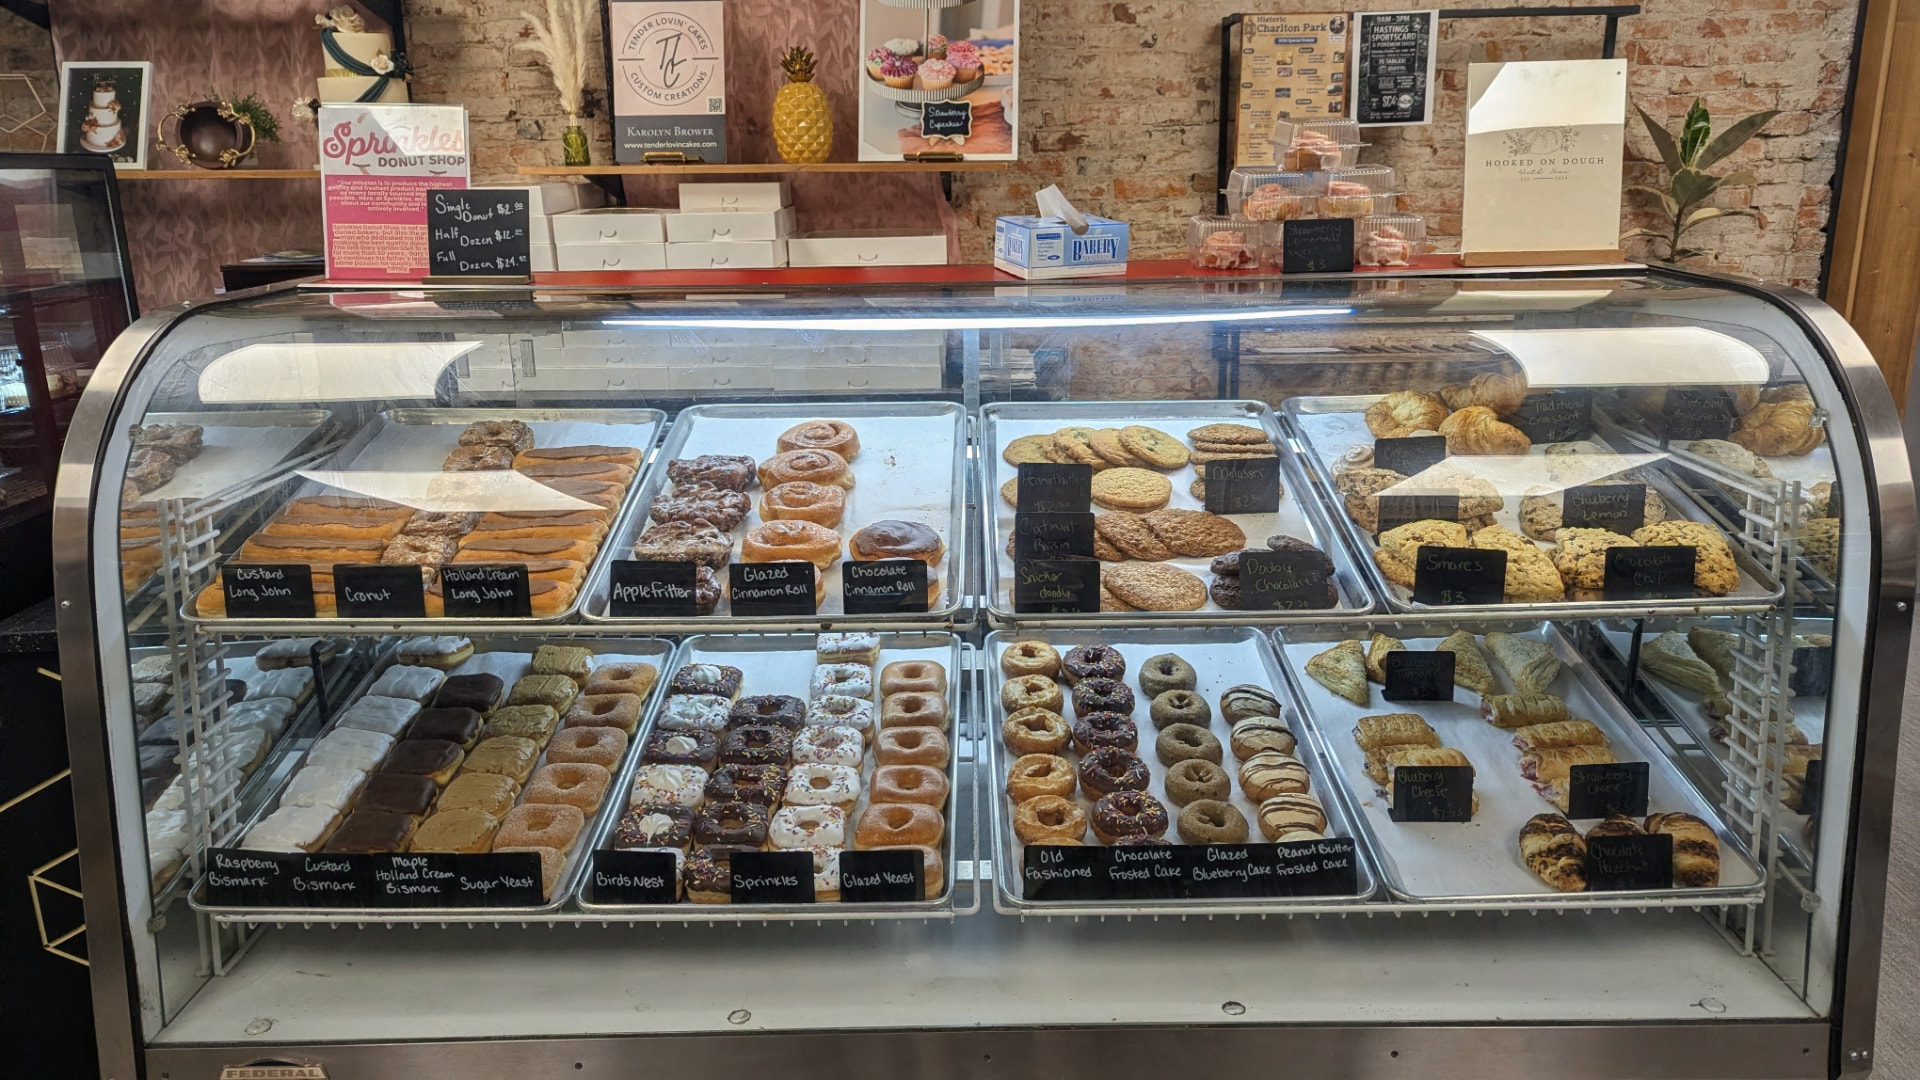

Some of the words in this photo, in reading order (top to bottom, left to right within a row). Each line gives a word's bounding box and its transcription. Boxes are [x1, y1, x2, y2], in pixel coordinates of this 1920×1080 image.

[629, 22, 654, 50] TENDER
[656, 17, 687, 27] LOVIN'
[687, 25, 708, 50] CAKES
[1257, 23, 1300, 33] Charlton
[1303, 22, 1327, 32] Park
[1373, 25, 1409, 34] HASTINGS
[1371, 33, 1417, 41] SPORTSCARD
[631, 72, 662, 99] CUSTOM
[664, 71, 708, 101] CREATIONS
[323, 121, 464, 165] Sprinkles
[624, 141, 717, 149] www.tenderlovincakes.com
[378, 156, 425, 168] DONUT
[429, 155, 466, 167] SHOP
[1485, 159, 1534, 167] HOOKED
[1540, 158, 1556, 166] ON
[1562, 156, 1605, 166] DOUGH
[435, 194, 471, 220] Single
[462, 208, 494, 222] Donut
[435, 227, 459, 240] Half
[460, 235, 493, 247] Dozen
[436, 251, 456, 262] Full
[1073, 238, 1119, 261] BAKERY
[460, 261, 495, 271] Dozen
[1571, 489, 1629, 508] Blueberry
[1583, 510, 1628, 521] Lemon
[1033, 538, 1070, 552] Raisin
[1426, 554, 1484, 571] Smores
[237, 568, 285, 581] Custard
[443, 569, 485, 582] Holland
[486, 569, 520, 581] Cream
[744, 567, 790, 583] Glazed
[852, 565, 908, 577] Chocolate
[229, 585, 260, 601] Long
[260, 585, 292, 598] John
[344, 586, 392, 602] Cronut
[452, 587, 481, 603] Long
[481, 587, 514, 600] John
[613, 582, 650, 600] Apple
[731, 585, 784, 600] Cinnamon
[784, 583, 809, 596] Roll
[844, 583, 897, 597] Cinnamon
[897, 581, 917, 593] Roll
[1040, 849, 1064, 863] Old
[1115, 849, 1173, 862] Chocolate
[1207, 848, 1248, 862] Glazed
[1277, 846, 1317, 859] Peanut
[1318, 843, 1354, 855] Butter
[215, 853, 279, 874] Raspberry
[305, 857, 351, 872] Custard
[392, 856, 429, 870] Maple
[1276, 861, 1319, 875] Frosted
[1323, 858, 1349, 869] Cake
[209, 873, 269, 887] Bismark
[375, 869, 419, 881] Holland
[422, 868, 456, 879] Cream
[596, 871, 631, 888] Birds
[633, 874, 665, 888] Nest
[843, 873, 882, 888] Glazed
[884, 872, 915, 884] Yeast
[1025, 866, 1092, 880] Fashioned
[1108, 867, 1150, 880] Frosted
[1154, 866, 1182, 878] Cake
[1193, 867, 1248, 883] Blueberry
[1248, 864, 1272, 876] Cake
[293, 877, 357, 892] Bismark
[386, 882, 441, 894] Bismark
[460, 876, 498, 893] Sugar
[500, 875, 534, 888] Yeast
[733, 874, 799, 891] Sprinkles
[226, 1069, 319, 1079] FEDERAL
